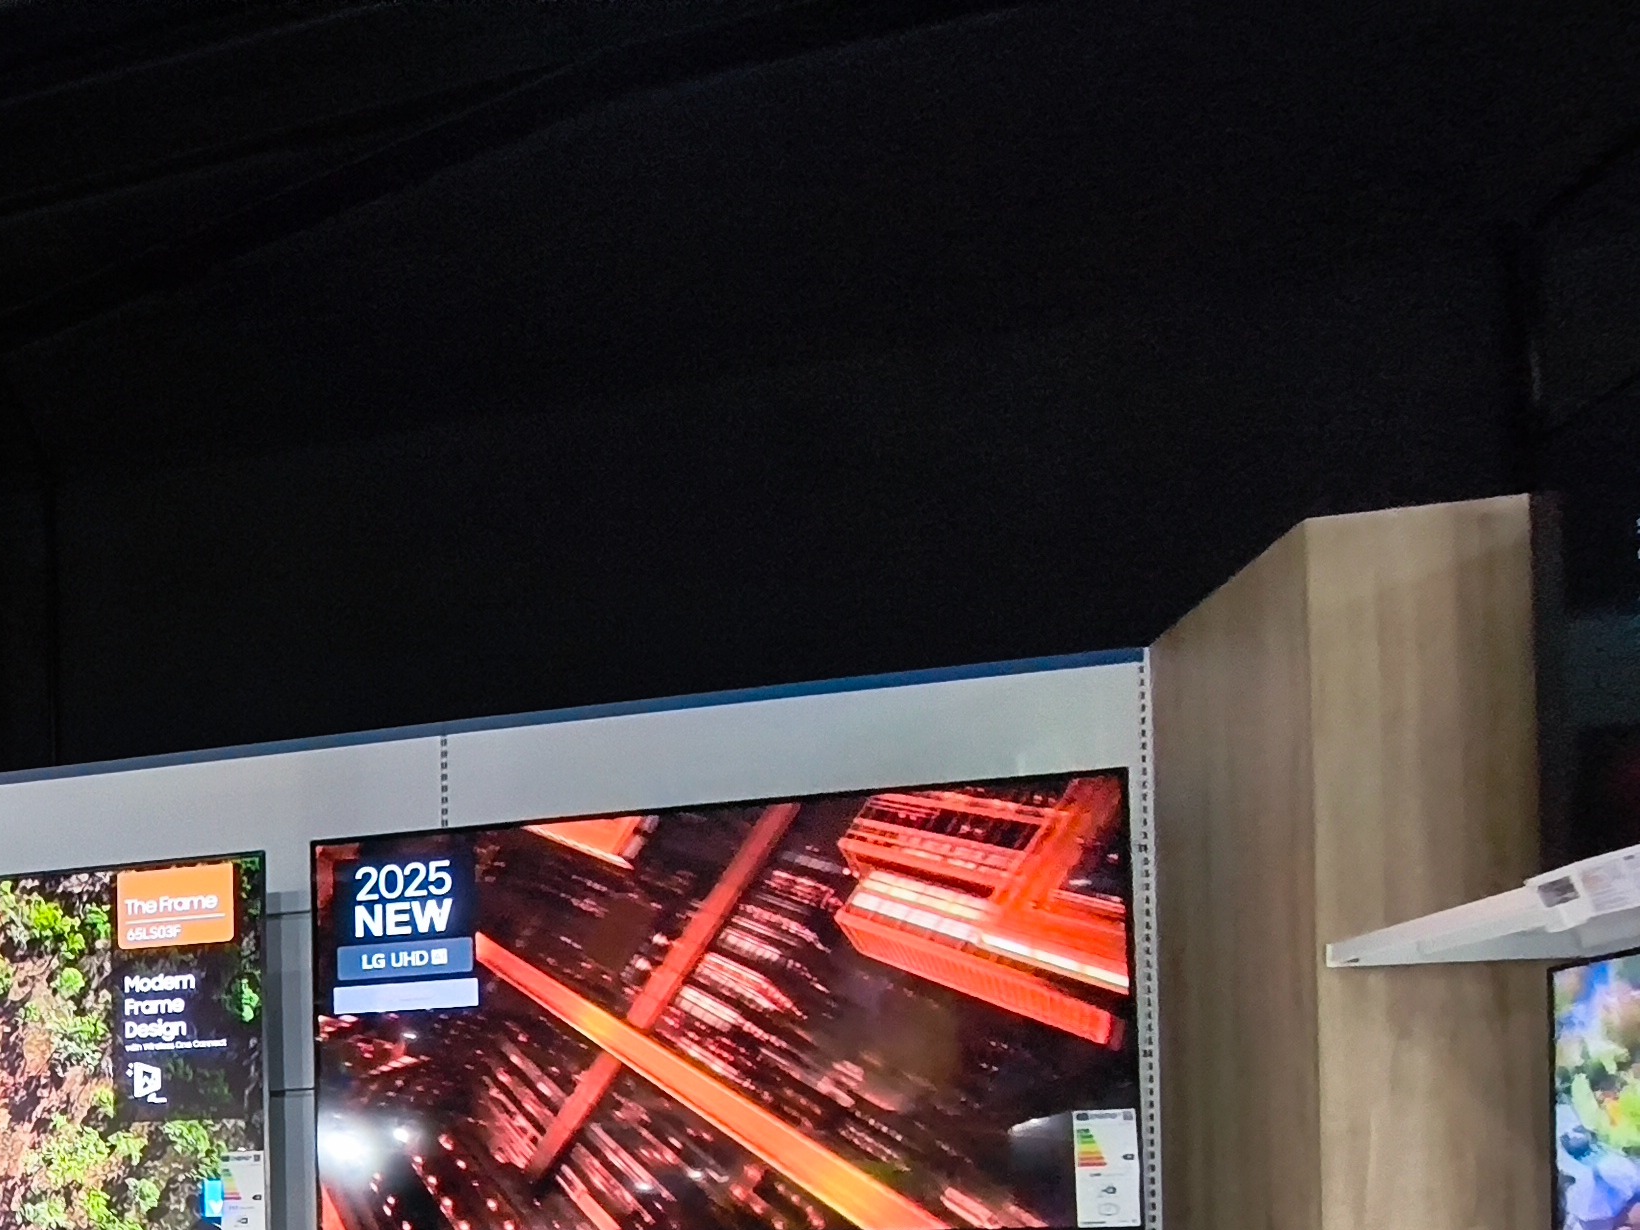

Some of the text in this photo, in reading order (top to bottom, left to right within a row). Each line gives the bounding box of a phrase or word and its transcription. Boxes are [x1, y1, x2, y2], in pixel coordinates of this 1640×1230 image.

[354, 859, 453, 901] 2025
[124, 894, 218, 916] The Frame
[354, 898, 453, 938] NEW
[126, 924, 182, 941] 65LS03F
[361, 953, 386, 970] LG
[390, 950, 429, 968] UHD
[124, 973, 196, 993] Modern
[124, 997, 185, 1015] Frame
[124, 1018, 187, 1041] Design
